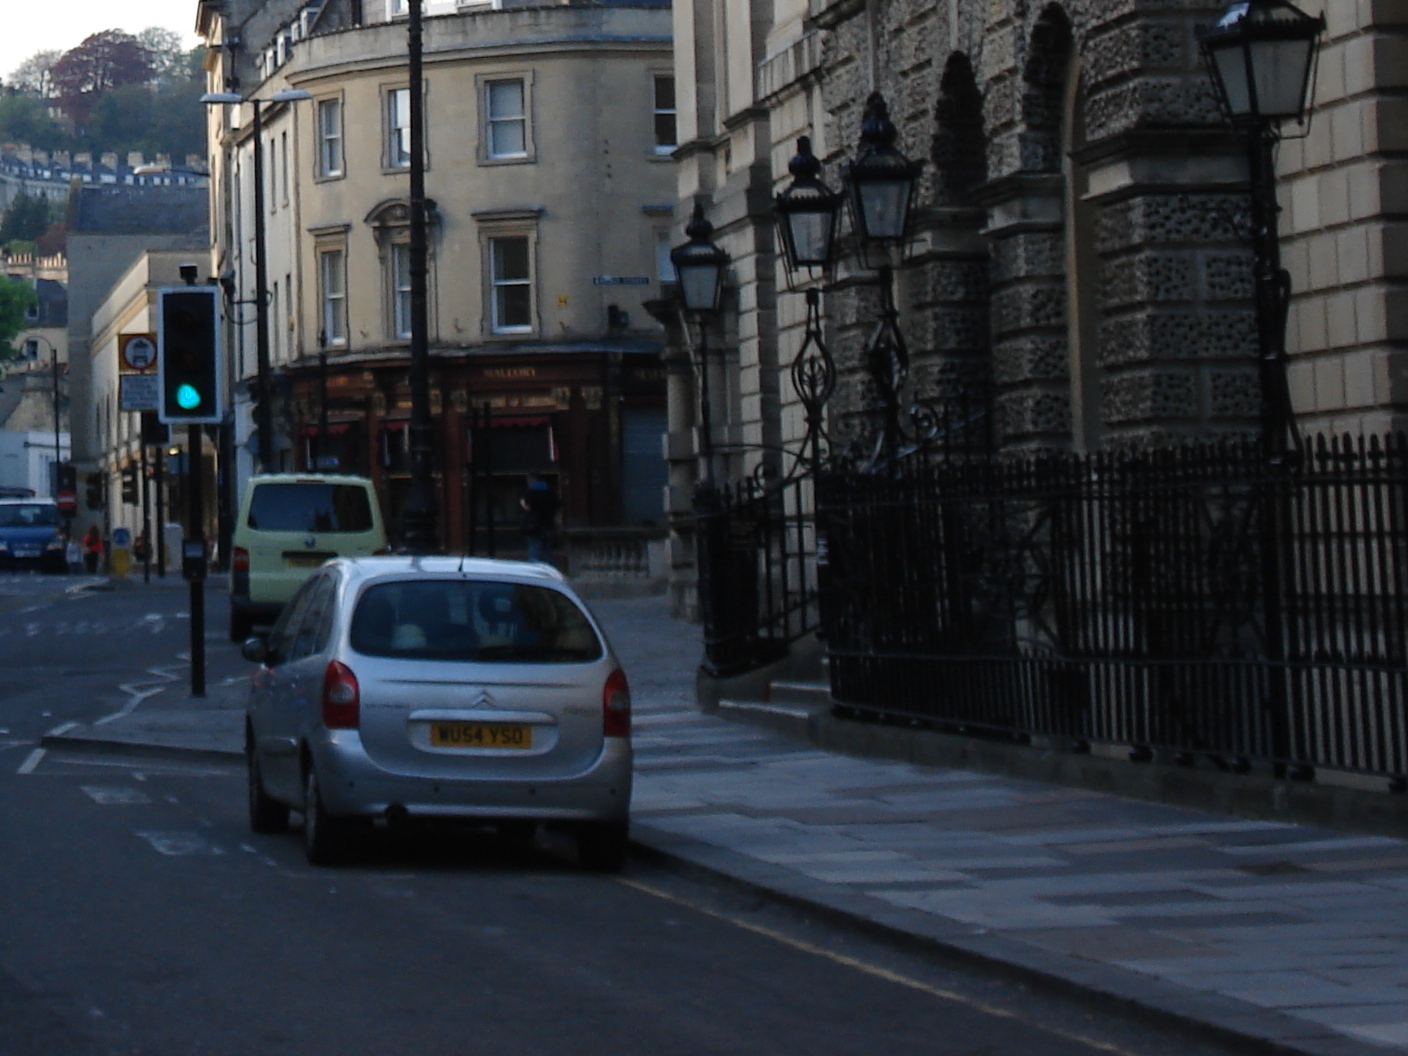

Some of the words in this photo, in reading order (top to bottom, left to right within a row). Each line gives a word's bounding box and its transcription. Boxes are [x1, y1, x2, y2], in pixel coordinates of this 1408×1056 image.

[483, 366, 536, 378] MALLORY
[438, 725, 484, 743] WU54
[488, 726, 523, 744] YSO
